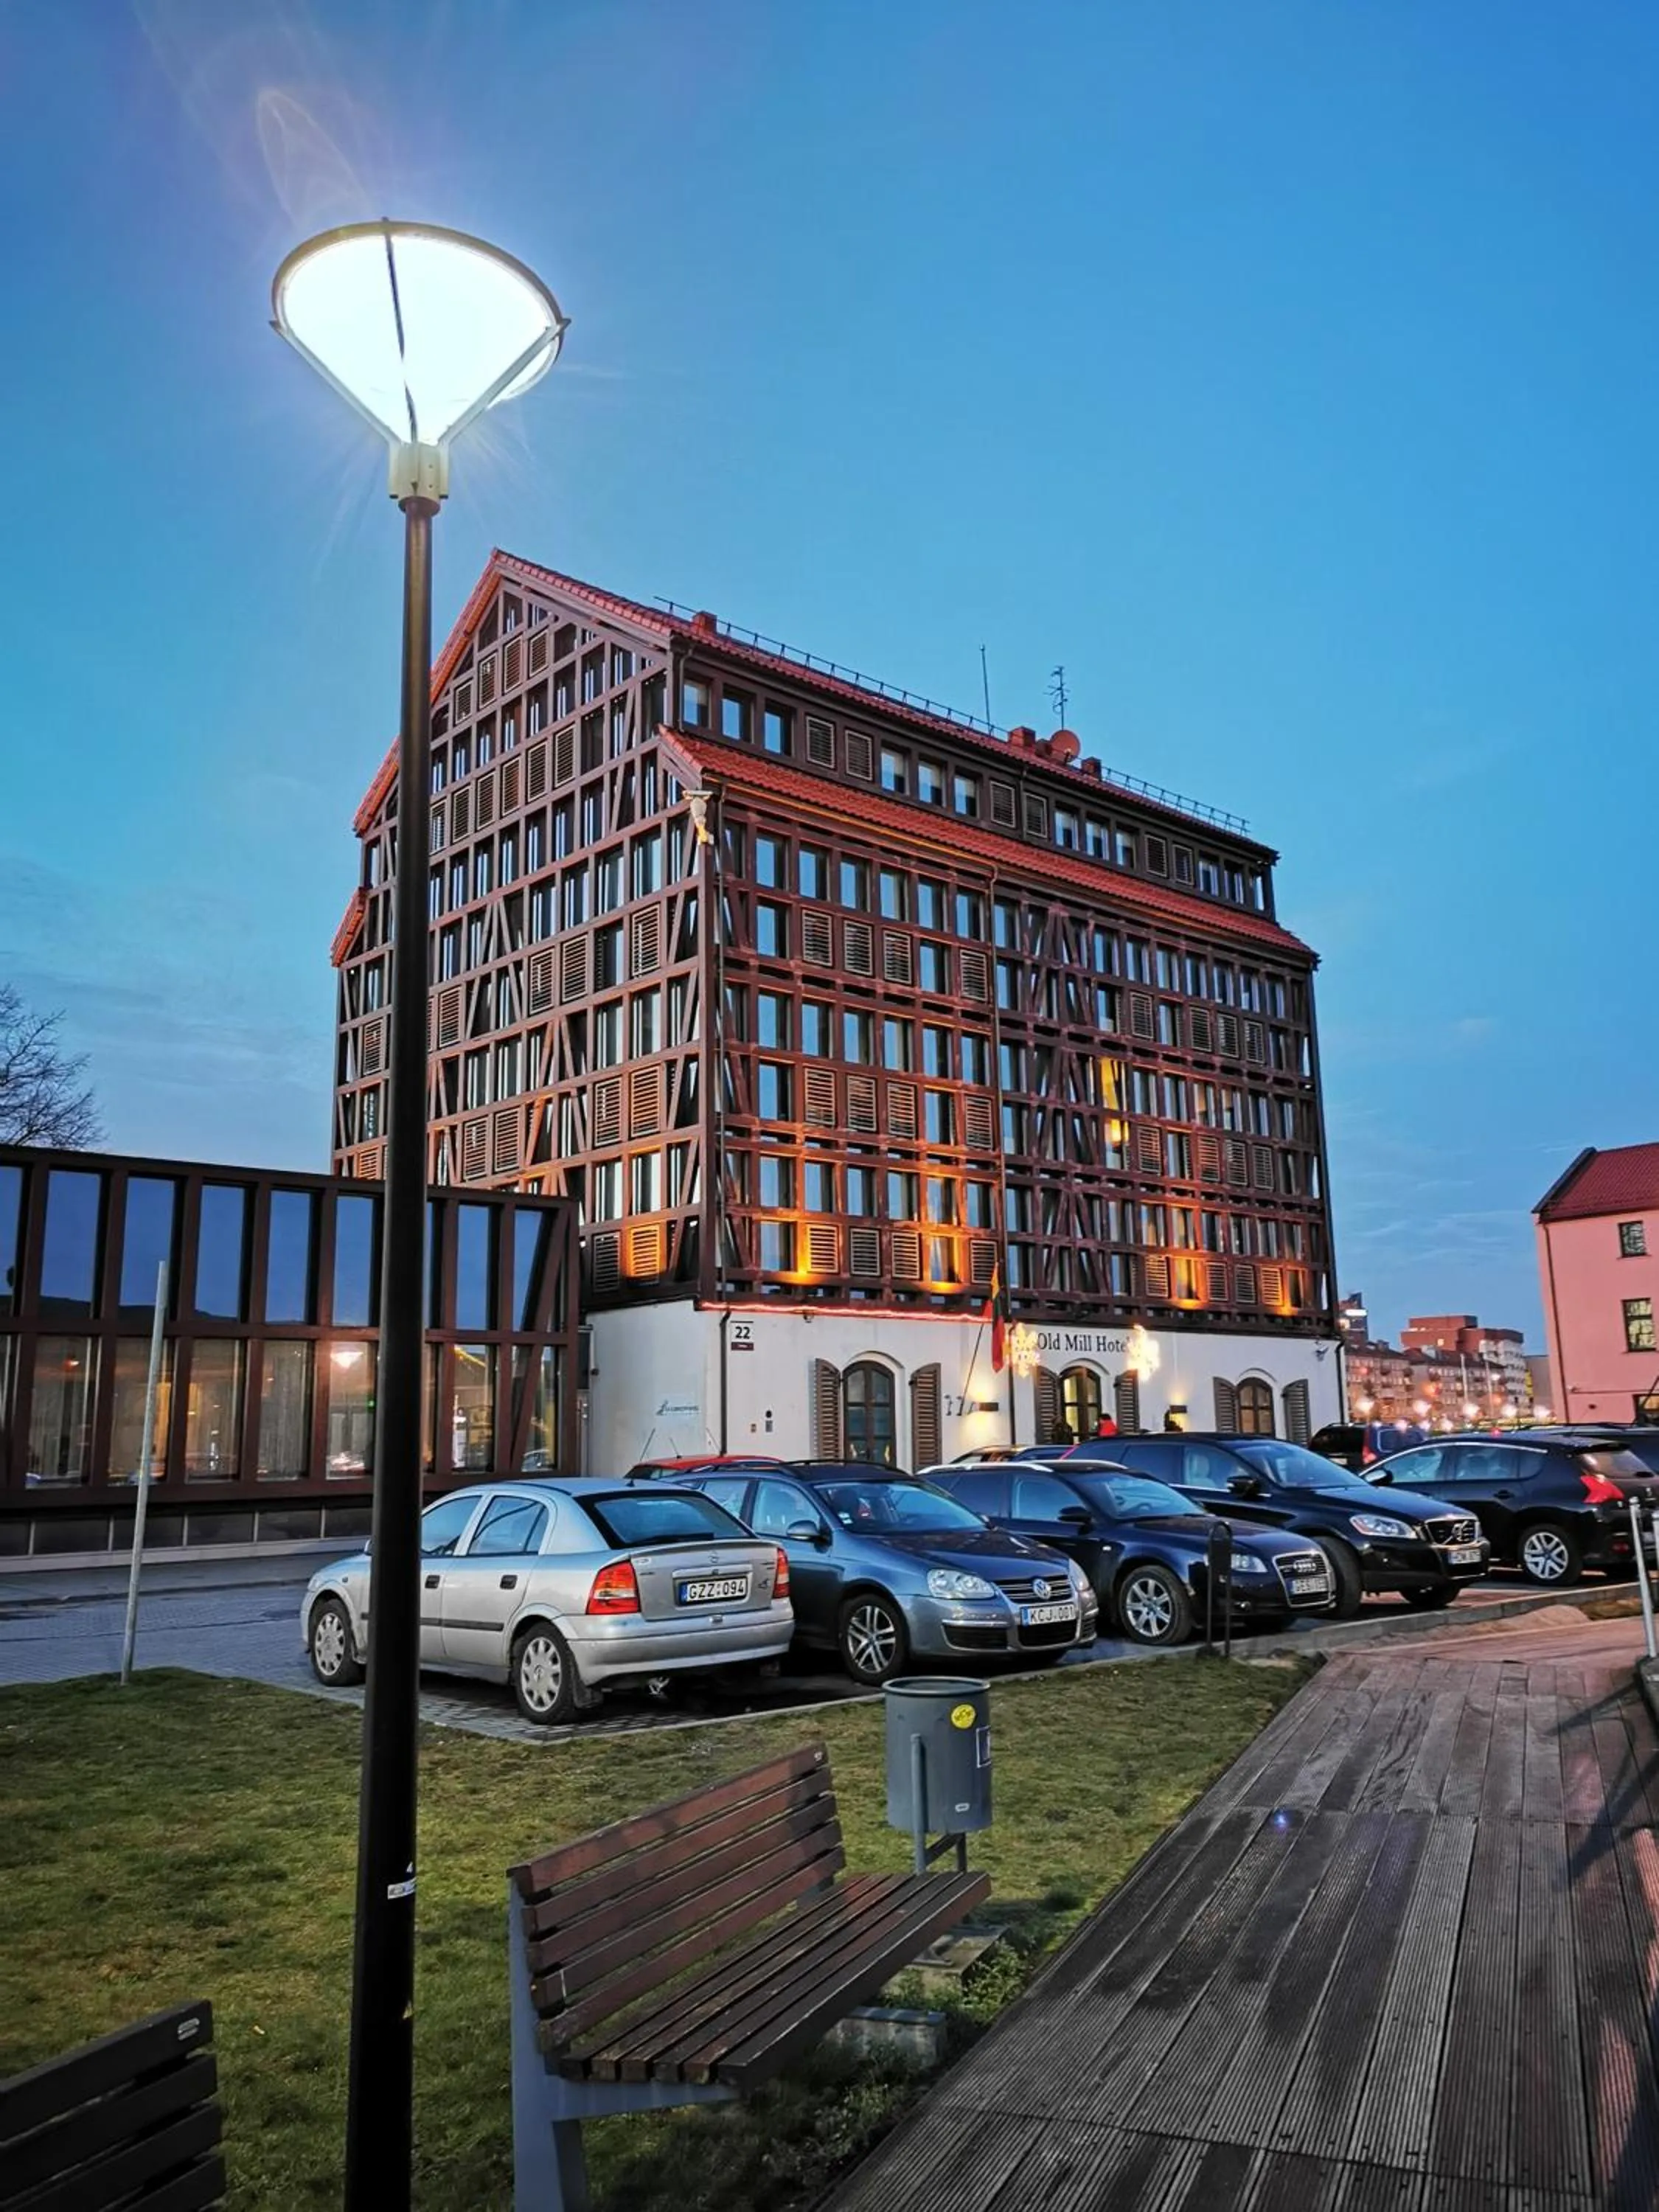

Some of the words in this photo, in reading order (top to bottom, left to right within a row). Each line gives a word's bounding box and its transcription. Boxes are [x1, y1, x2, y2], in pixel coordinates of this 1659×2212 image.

[735, 1326, 750, 1339] 22
[1037, 1332, 1060, 1350] Old
[1065, 1333, 1092, 1352] Mill
[1096, 1335, 1130, 1353] Hote
